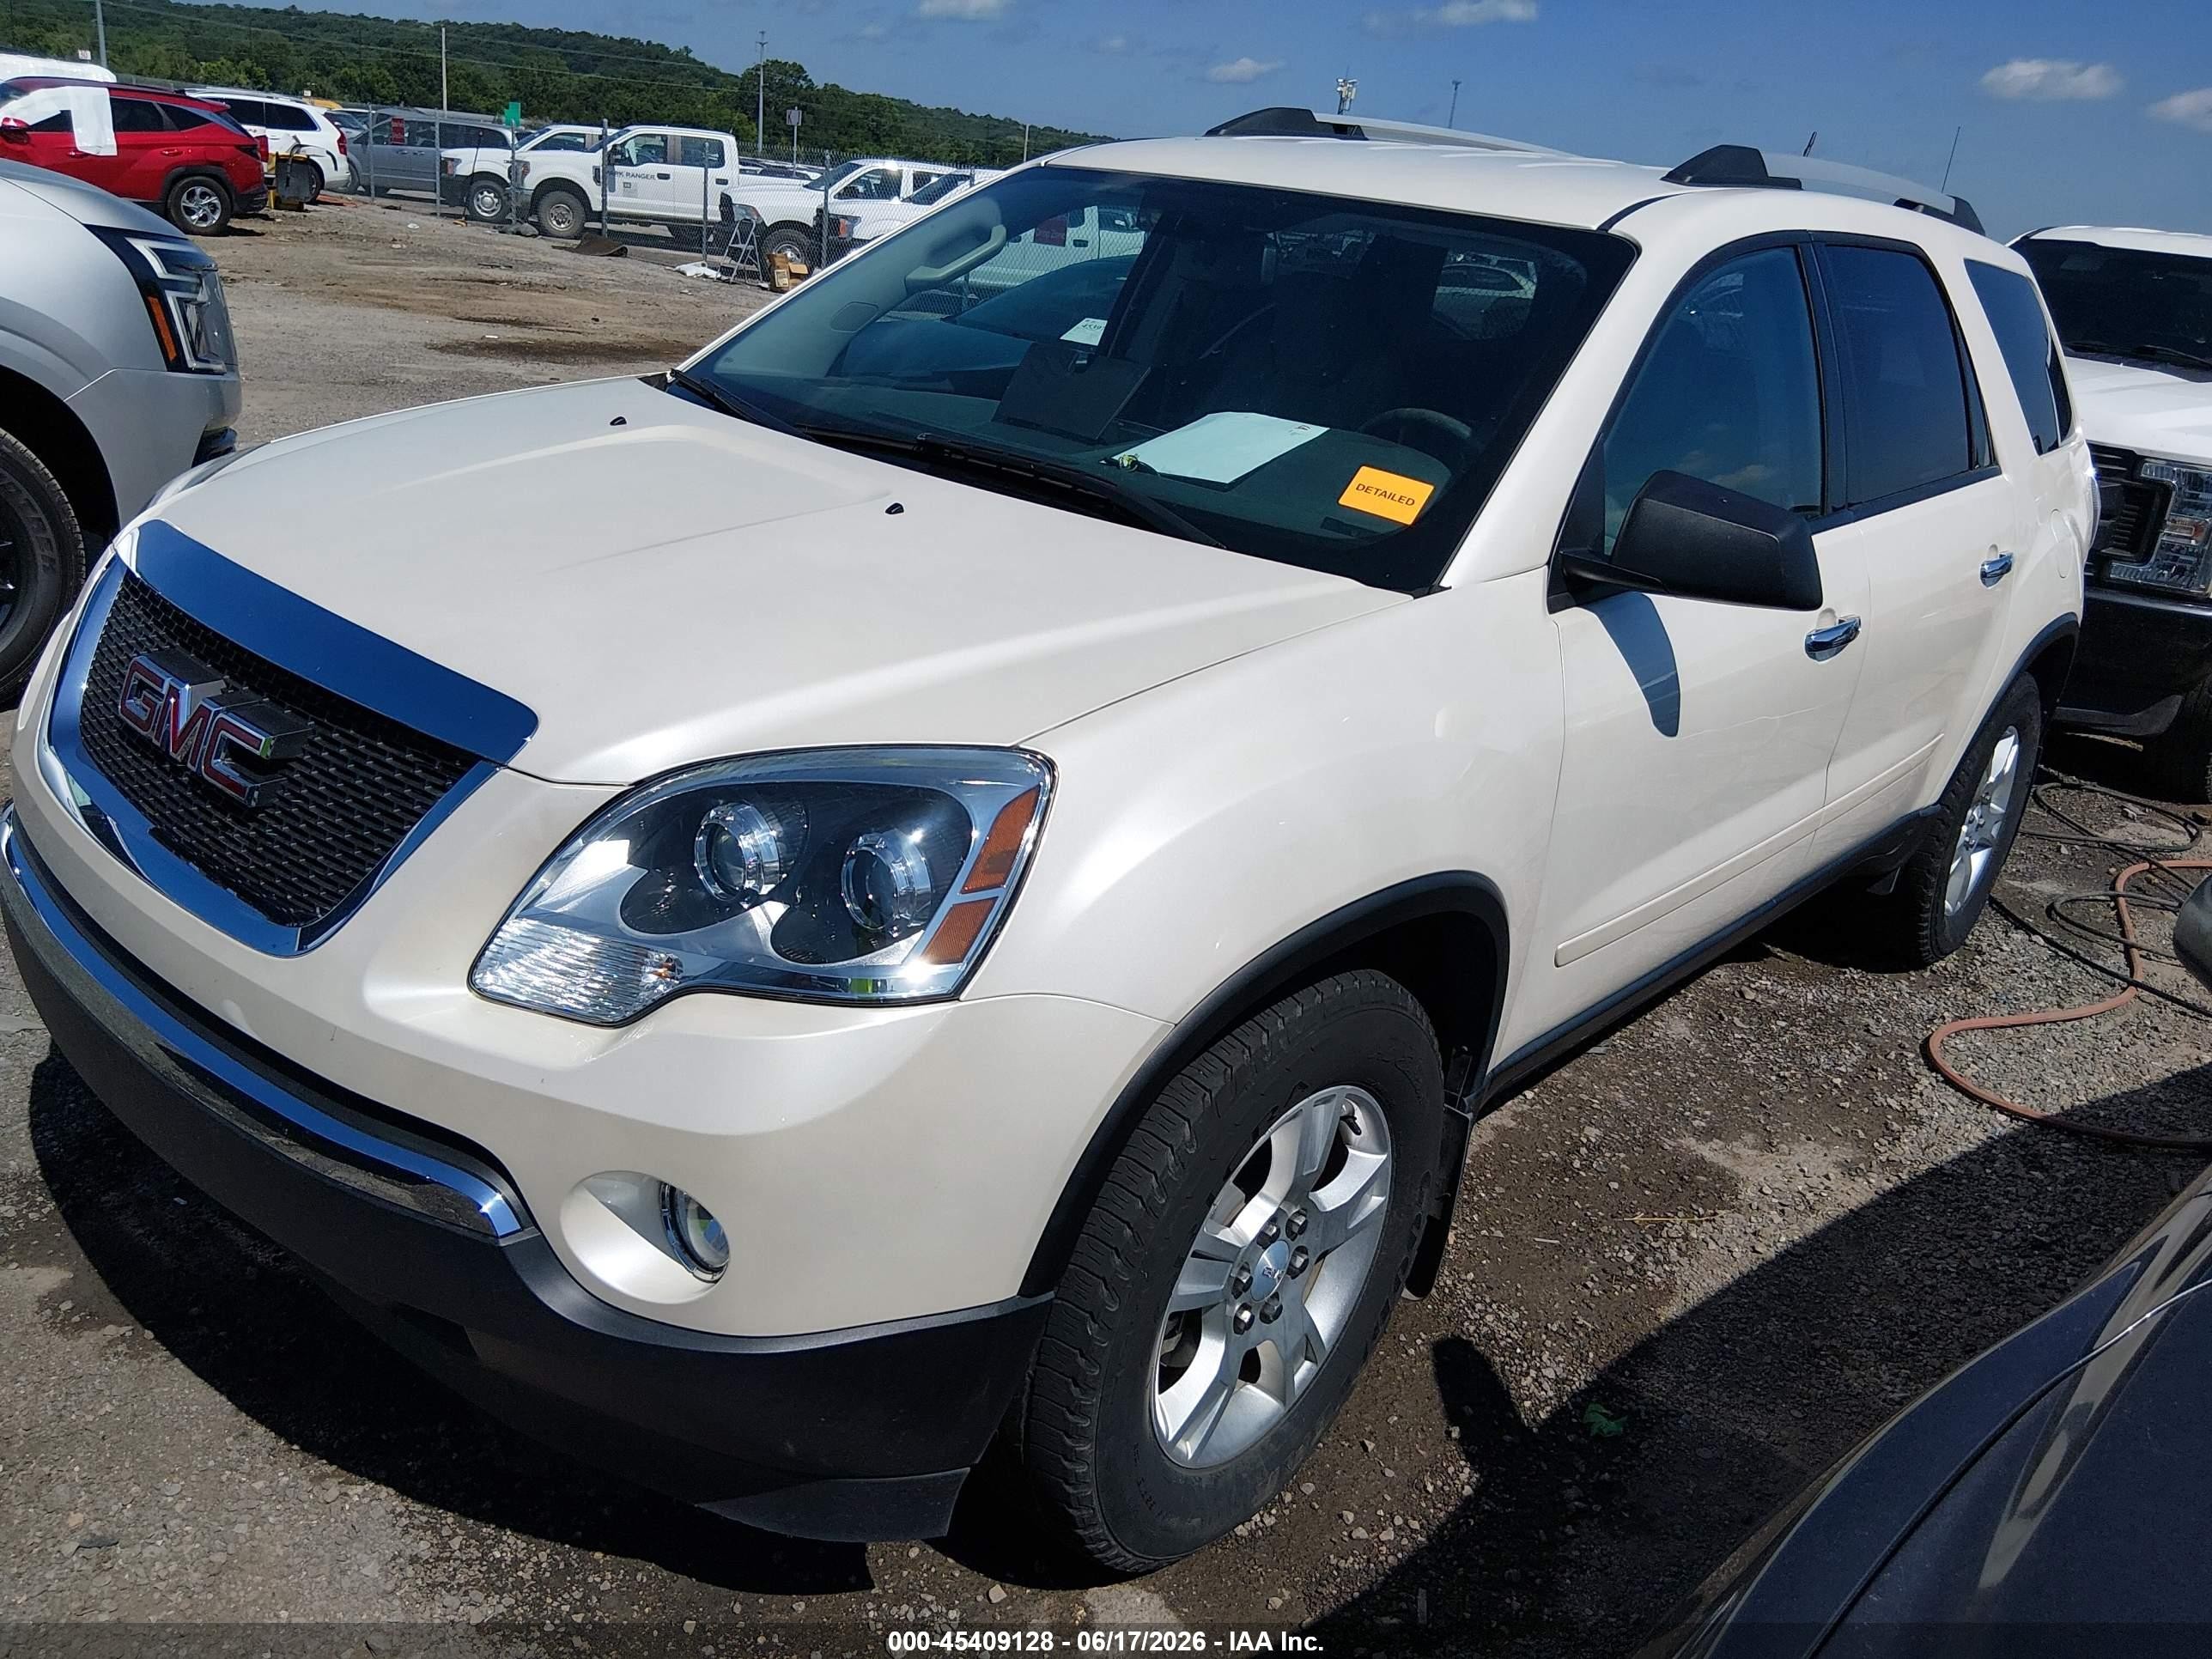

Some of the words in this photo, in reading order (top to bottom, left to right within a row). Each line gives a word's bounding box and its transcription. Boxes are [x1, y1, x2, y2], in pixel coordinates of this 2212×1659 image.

[625, 172, 656, 180] RANGER
[1355, 483, 1416, 507] DETAILED
[118, 655, 271, 808] GMC
